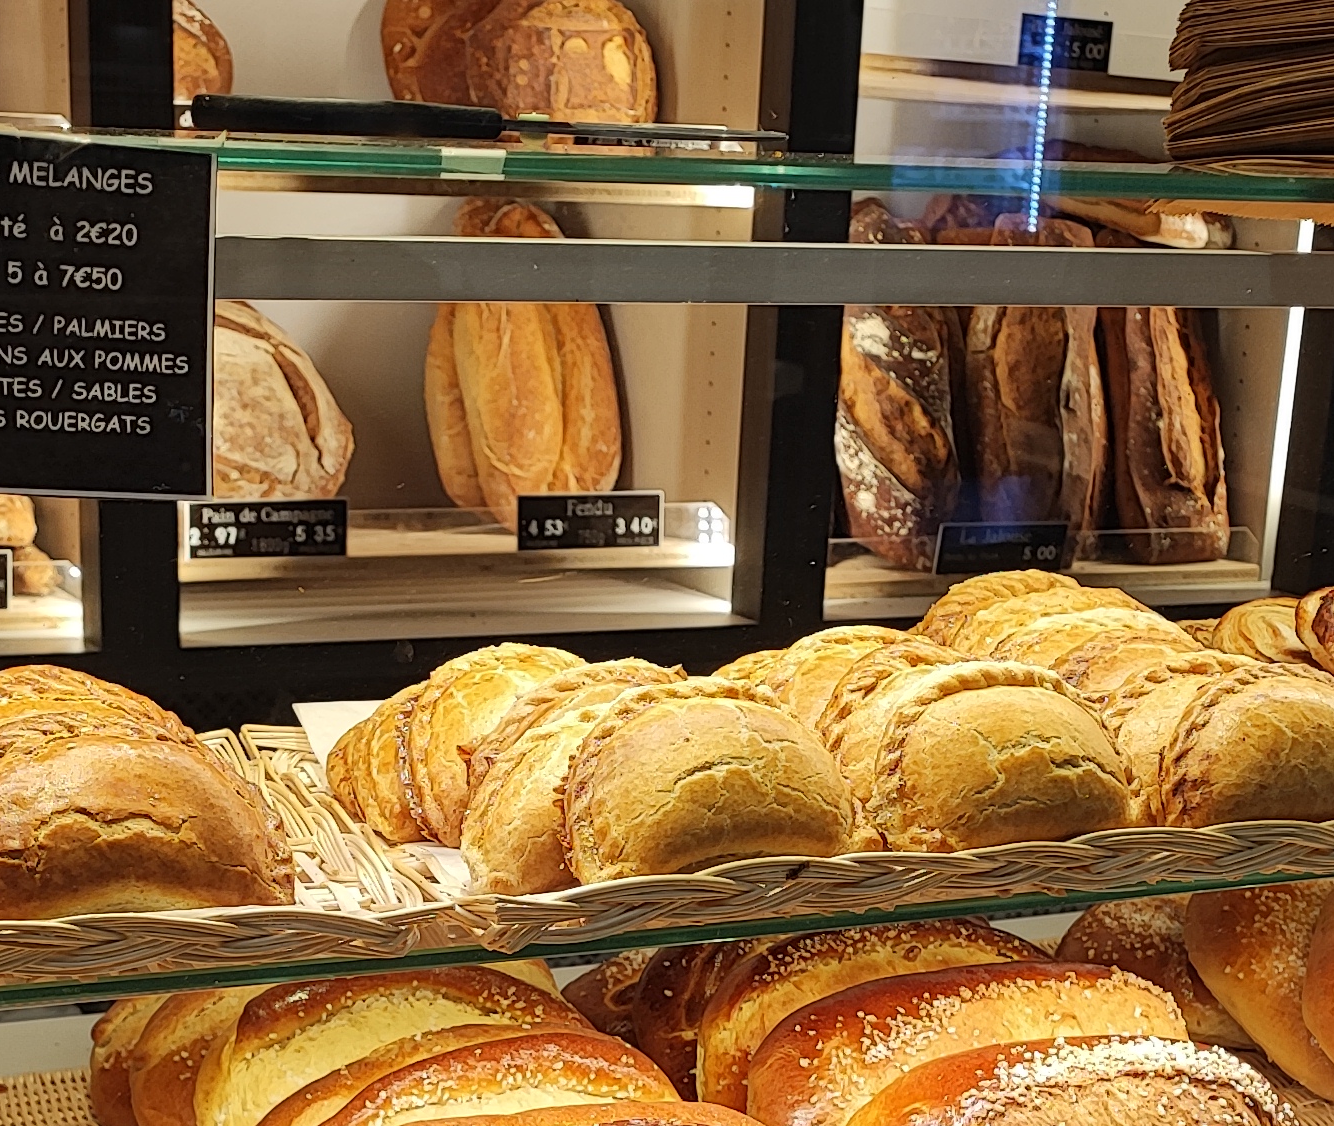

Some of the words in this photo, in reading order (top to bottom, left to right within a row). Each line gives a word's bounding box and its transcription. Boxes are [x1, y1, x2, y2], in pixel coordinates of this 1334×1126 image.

[9, 160, 153, 195] MELANGES
[50, 216, 64, 242] à
[76, 221, 138, 247] 2€20
[7, 261, 23, 284] 5
[33, 262, 49, 287] à
[59, 264, 123, 291] 7€50
[53, 315, 167, 342] PALMIERS
[37, 348, 86, 370] AUX
[94, 350, 189, 375] POMMES
[71, 382, 157, 404] SABLES
[16, 410, 152, 435] ROUERGATS
[201, 507, 236, 524] Pain
[239, 507, 258, 523] de
[567, 499, 614, 517] Fendu
